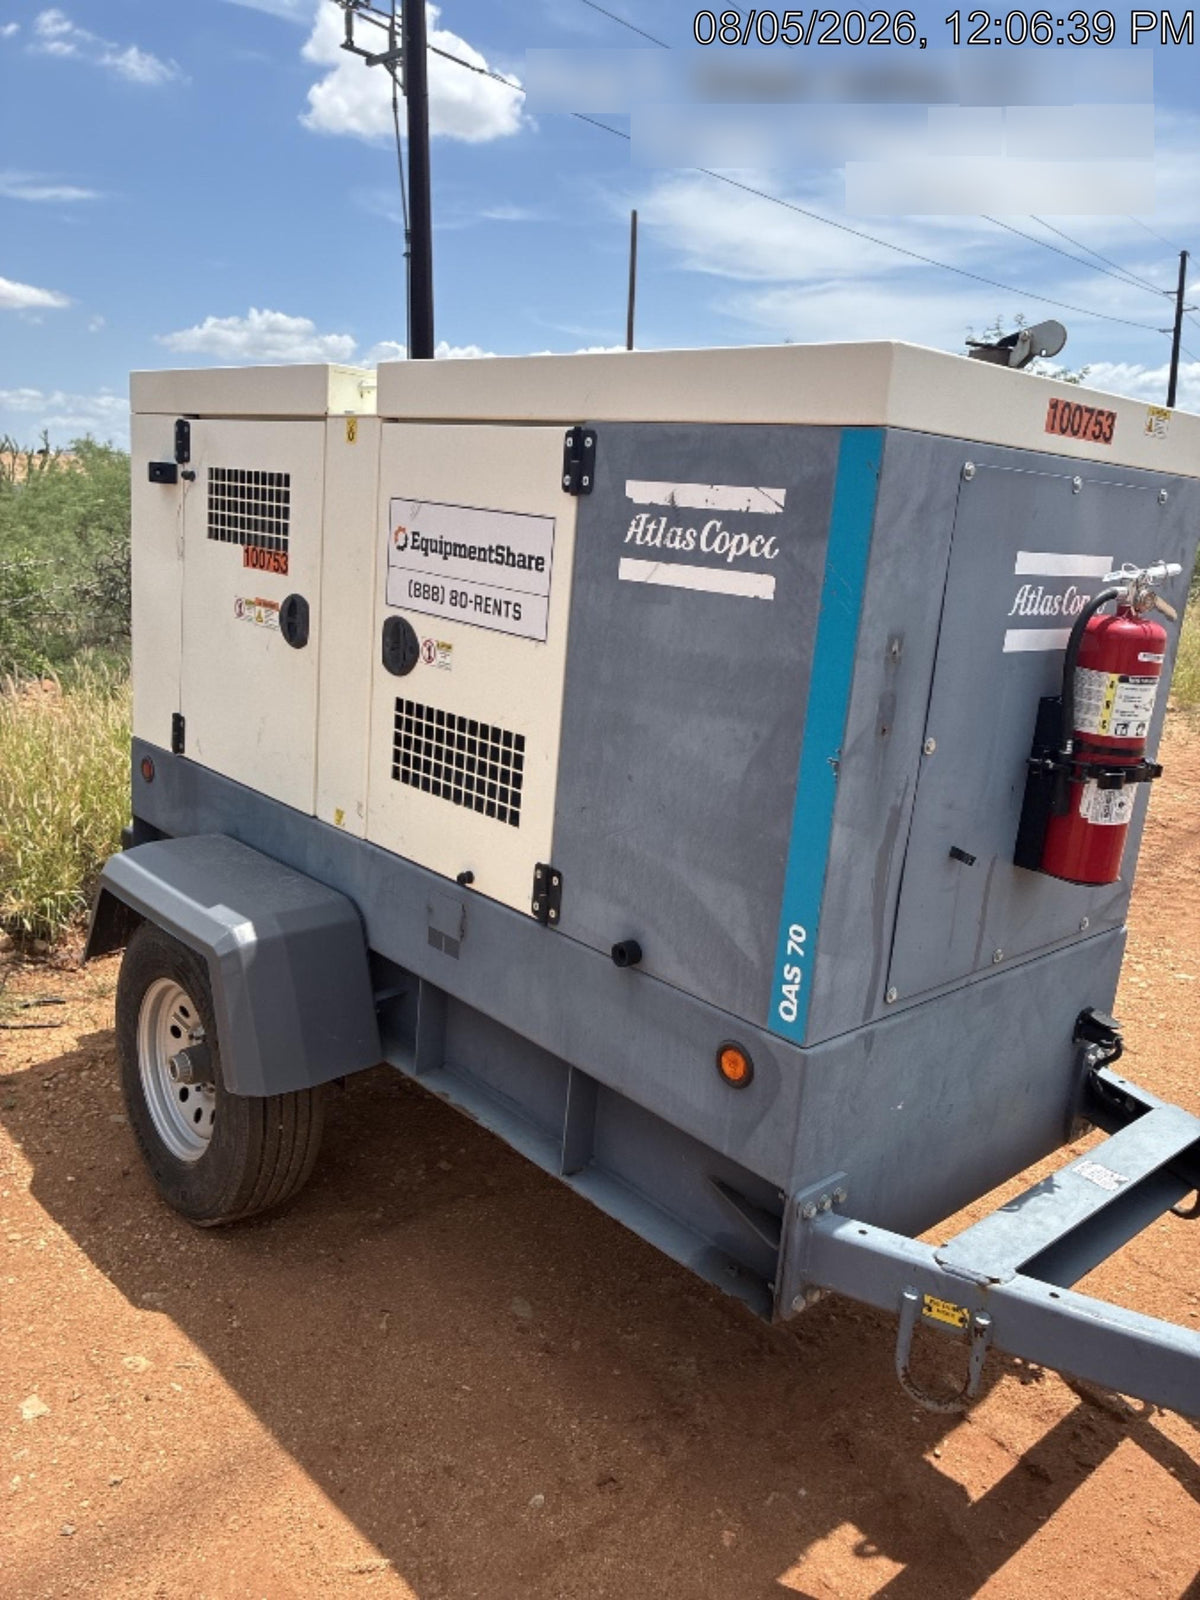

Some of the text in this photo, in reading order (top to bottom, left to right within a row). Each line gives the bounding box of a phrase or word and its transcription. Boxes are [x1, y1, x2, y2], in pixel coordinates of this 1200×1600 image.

[1050, 399, 1116, 442] 100753
[410, 531, 545, 573] EquipmentShare
[624, 513, 697, 551] Atlas
[243, 546, 289, 575] 100753
[408, 579, 522, 622] (888) 80-RENTS
[1008, 584, 1060, 616] Atlas
[779, 924, 806, 1022] QAS 70
